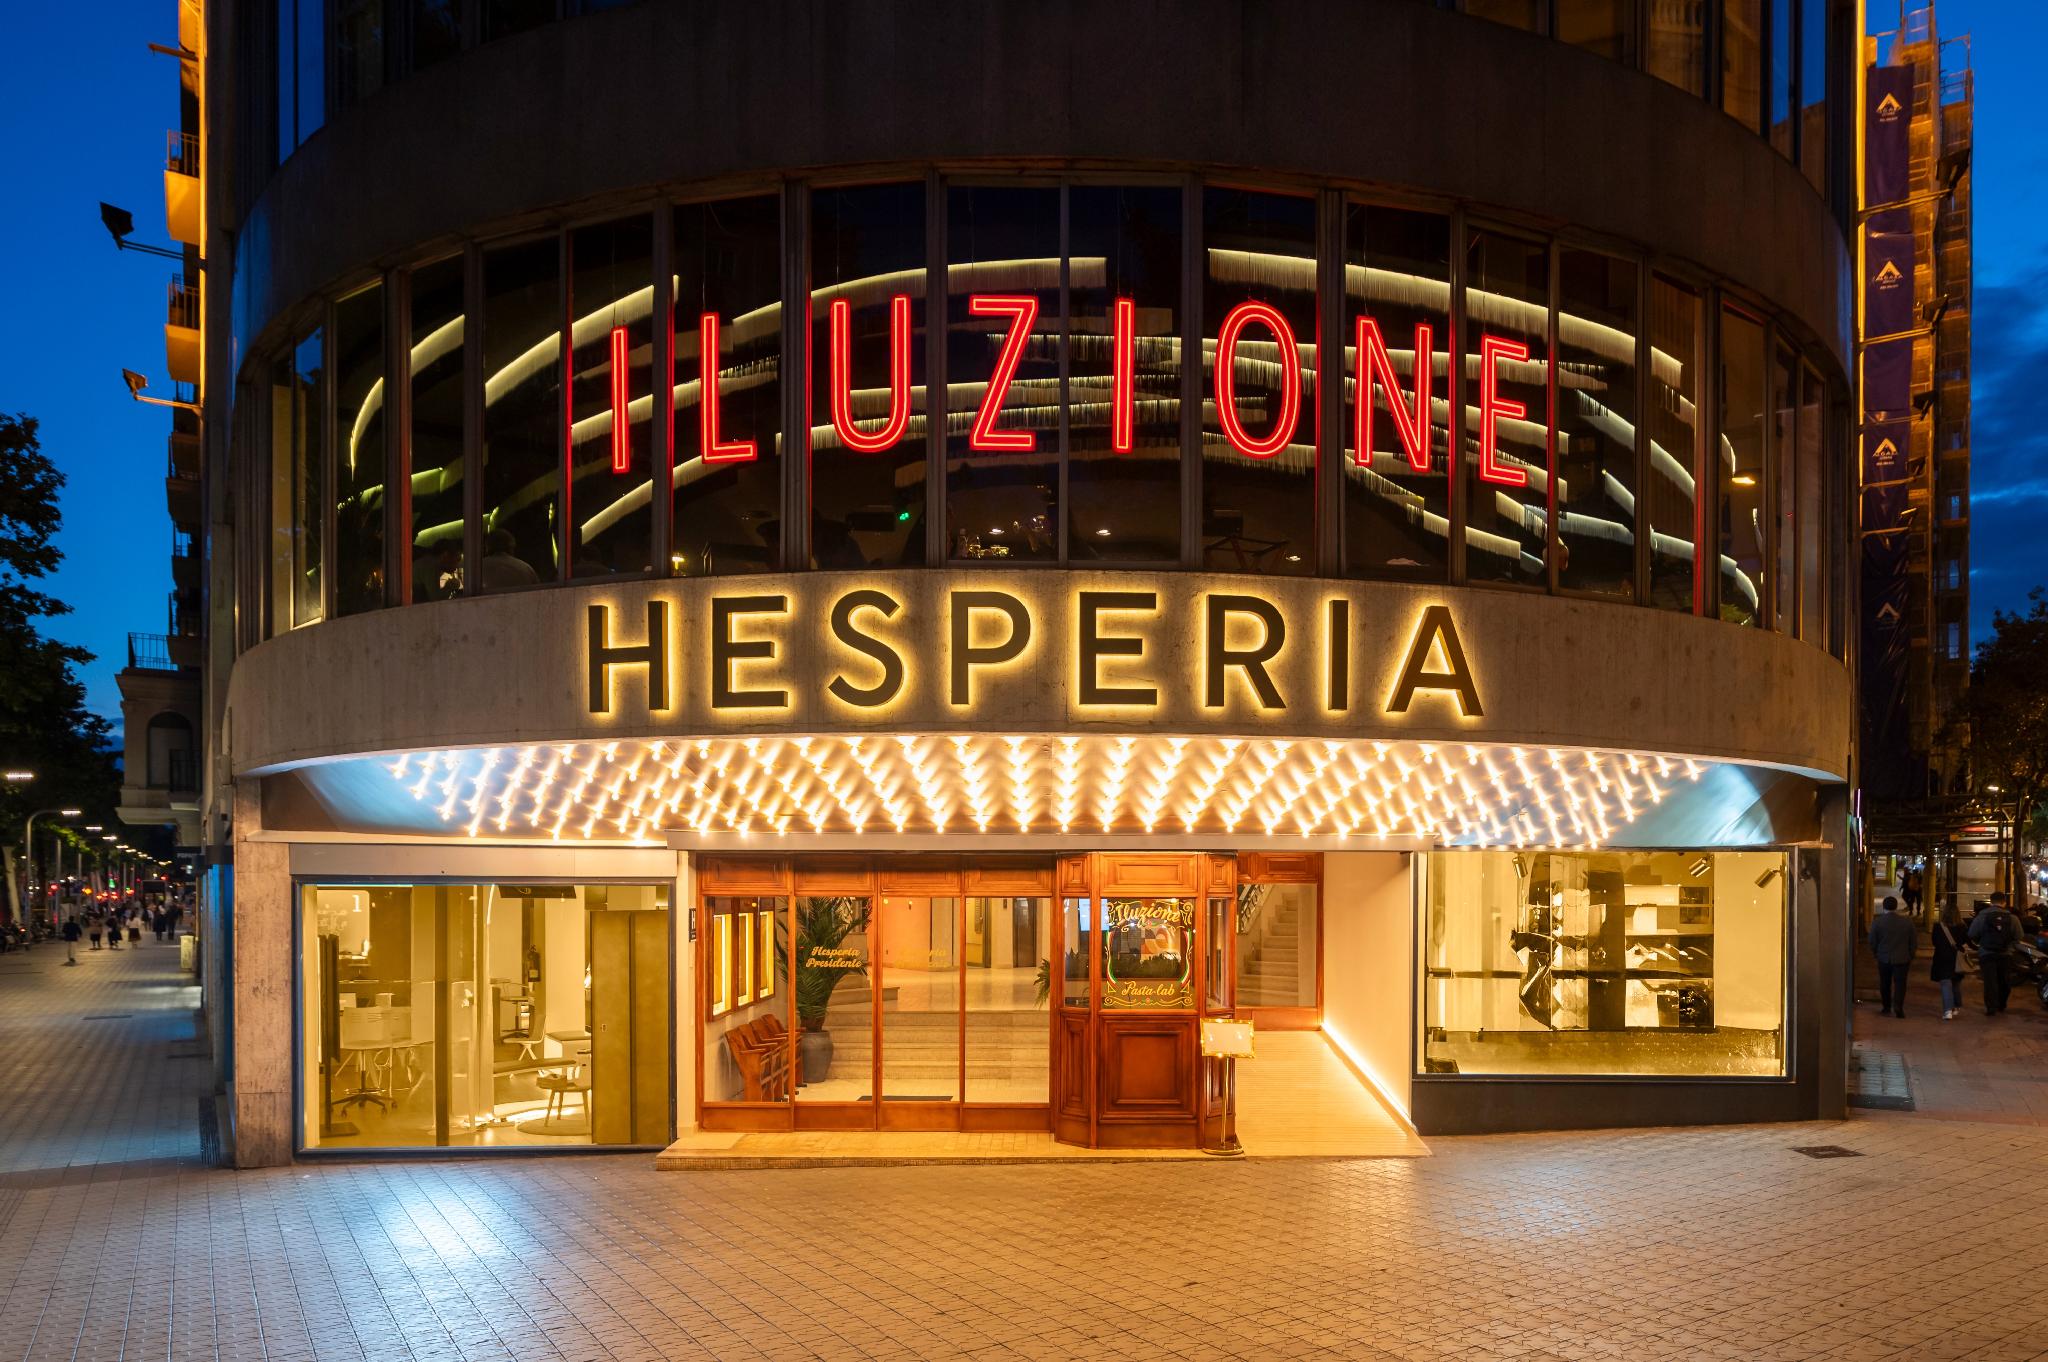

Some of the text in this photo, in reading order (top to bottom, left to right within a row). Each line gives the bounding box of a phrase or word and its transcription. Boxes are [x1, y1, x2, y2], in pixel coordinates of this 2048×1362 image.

[608, 294, 1530, 485] ILUZIONE
[588, 590, 1484, 718] HESPERIA
[1115, 902, 1181, 928] Iluzione
[805, 957, 862, 968] Presidente
[811, 945, 861, 959] Hesperia
